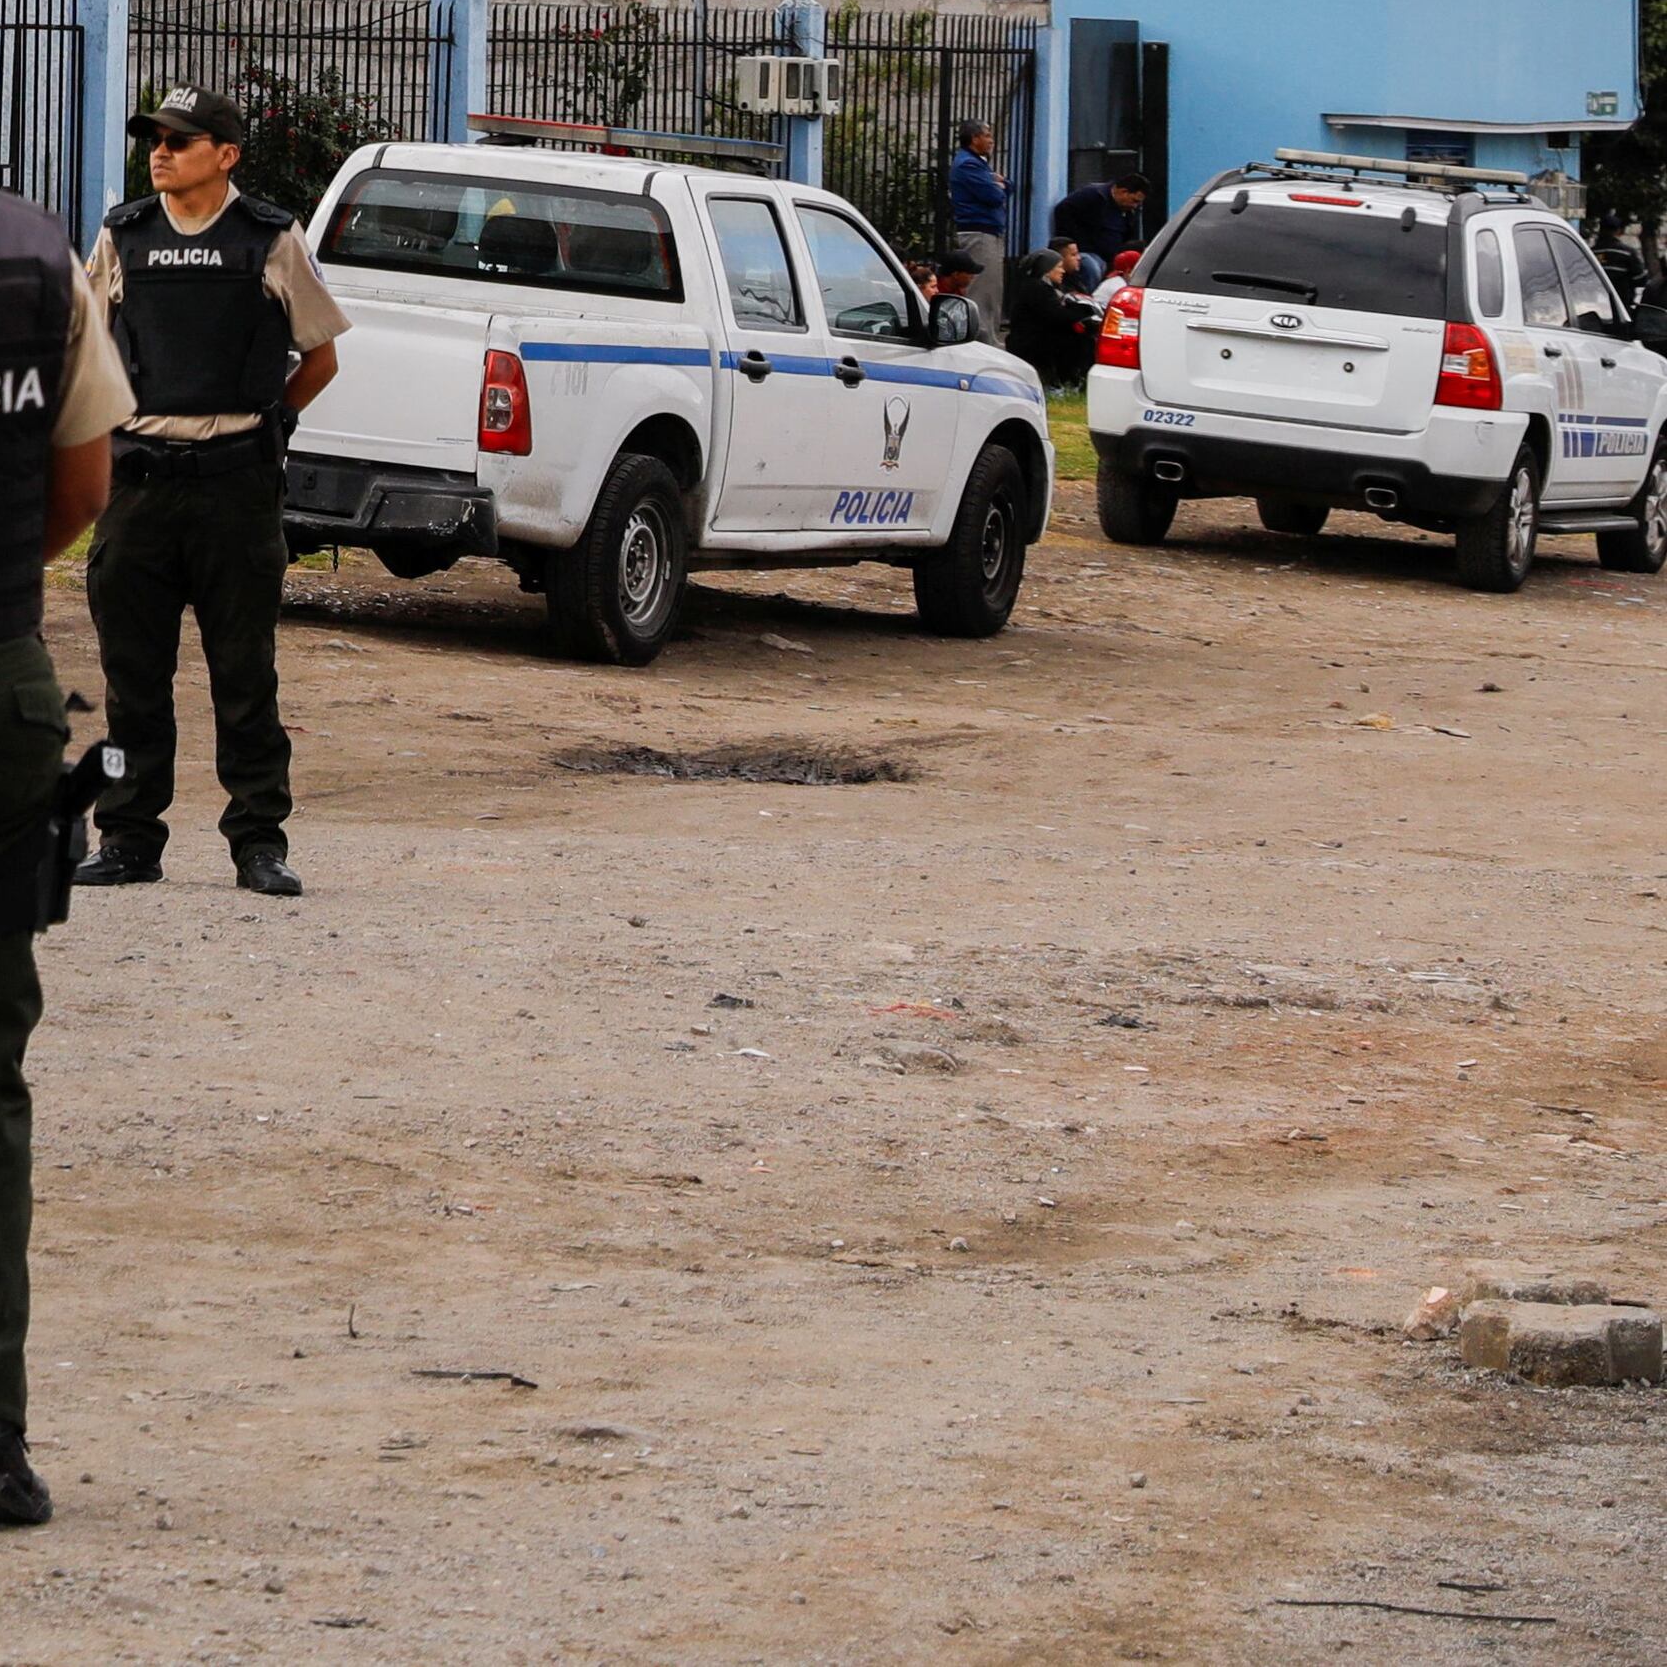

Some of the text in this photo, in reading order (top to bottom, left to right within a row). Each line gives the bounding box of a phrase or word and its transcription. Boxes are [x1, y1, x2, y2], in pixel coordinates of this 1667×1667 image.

[147, 248, 223, 267] POLICIA
[1271, 314, 1303, 329] KIA
[1143, 408, 1196, 428] 02322
[1597, 434, 1644, 455] POLICIA
[830, 490, 914, 525] POLICIA
